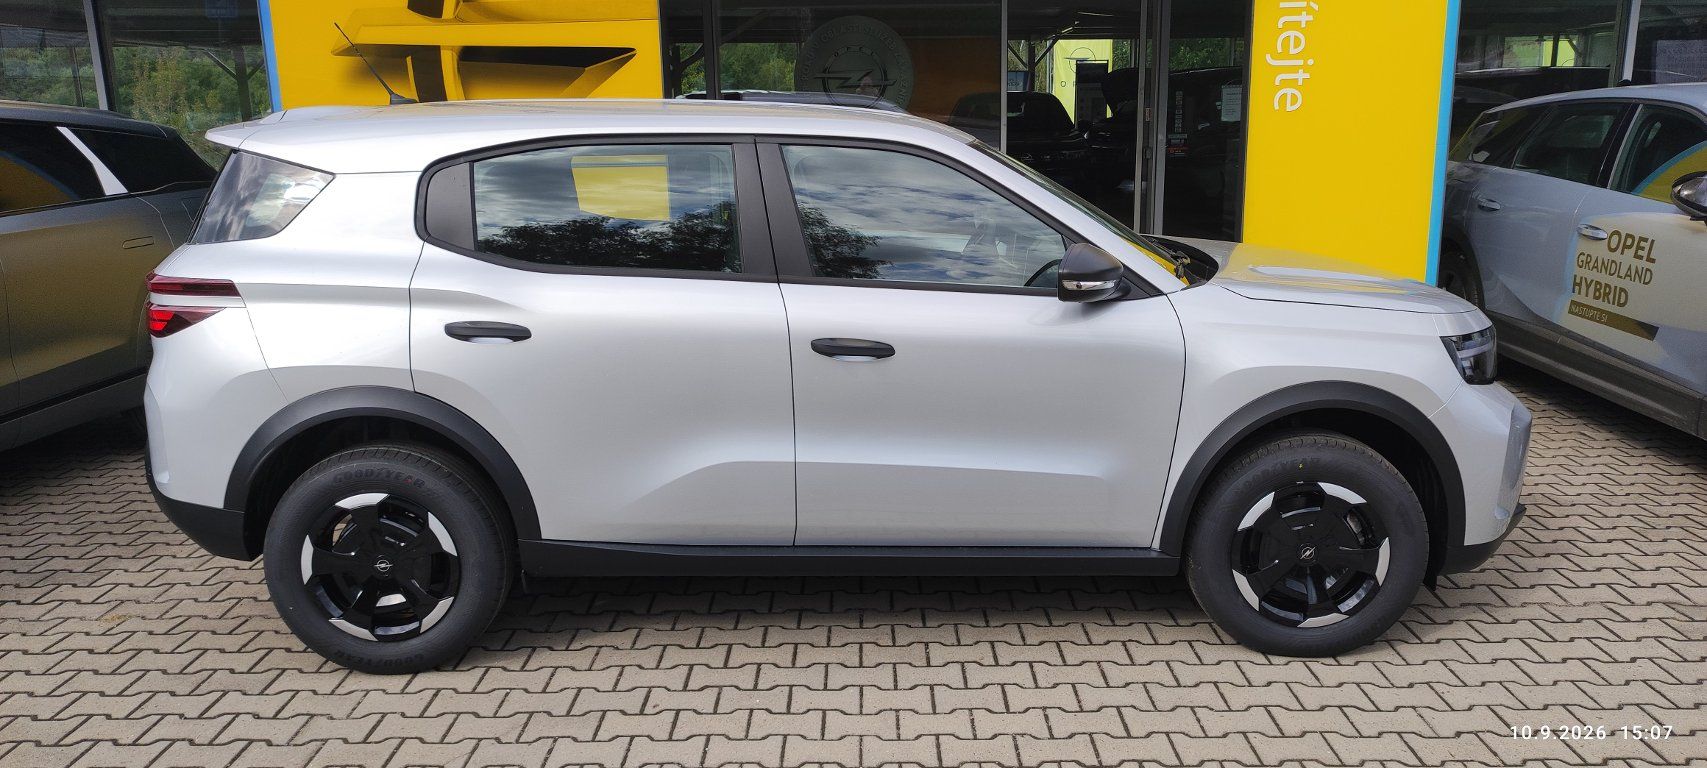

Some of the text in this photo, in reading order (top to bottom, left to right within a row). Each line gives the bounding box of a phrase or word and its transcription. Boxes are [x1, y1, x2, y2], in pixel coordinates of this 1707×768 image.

[1607, 230, 1656, 264] OPEL
[1577, 252, 1653, 285] GRANDLAND
[1572, 275, 1629, 307] HYBRID
